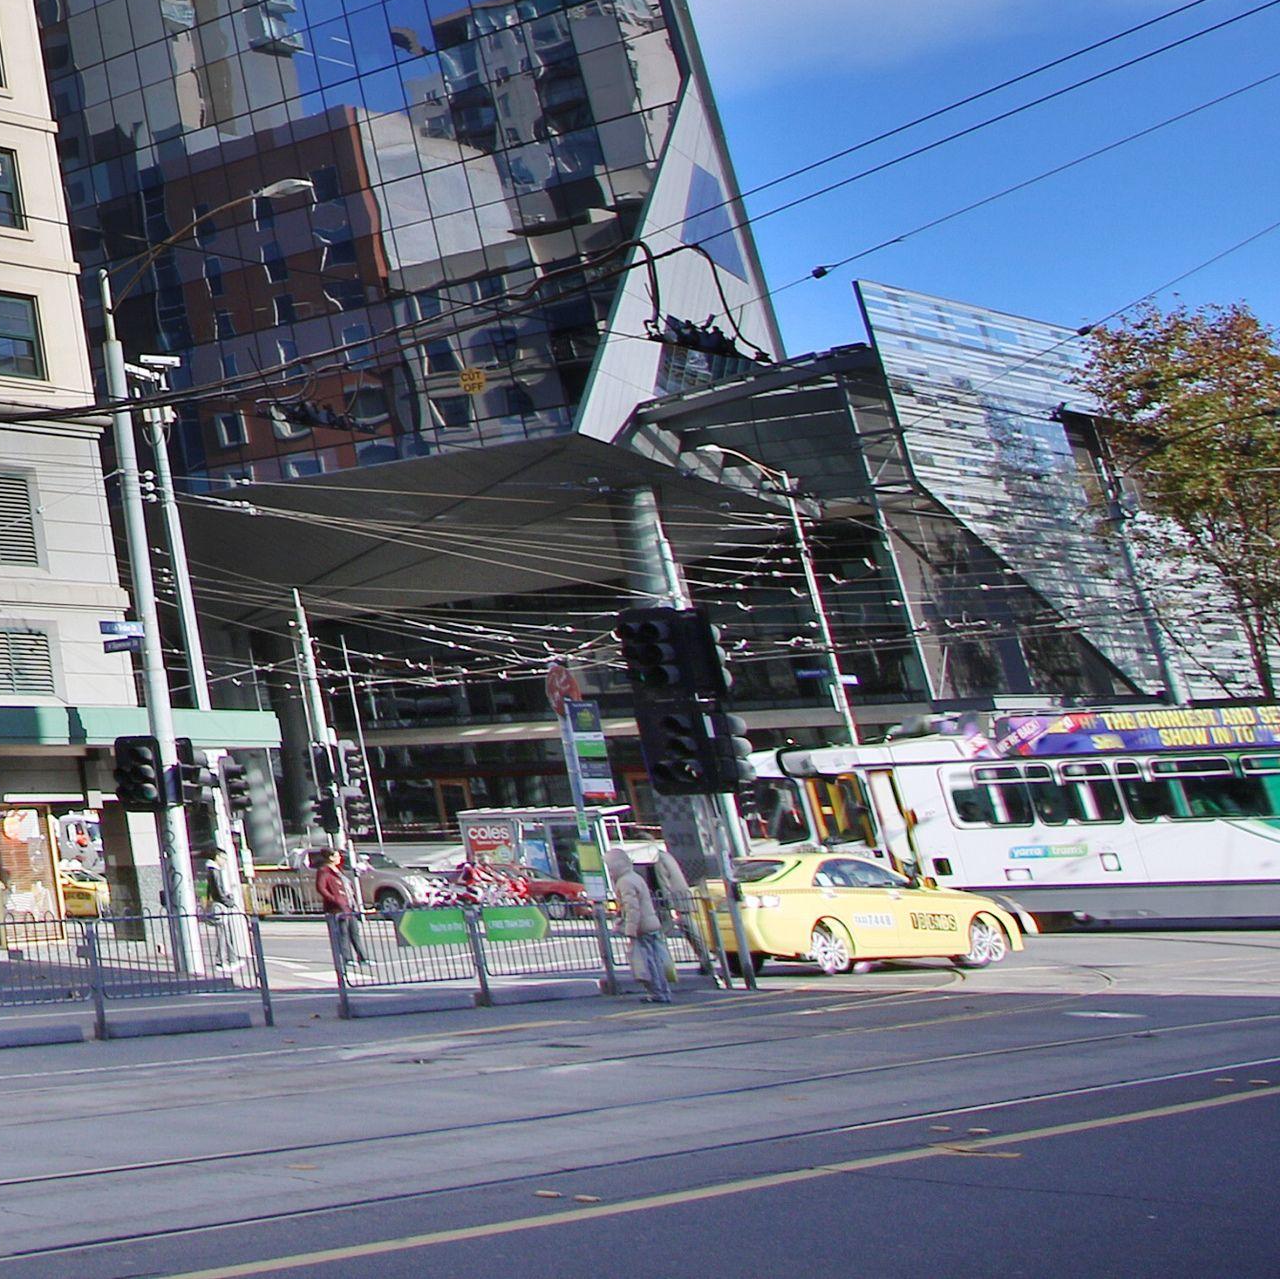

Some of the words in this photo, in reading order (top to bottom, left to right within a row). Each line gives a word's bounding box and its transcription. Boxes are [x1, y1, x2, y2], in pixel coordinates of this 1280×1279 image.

[461, 371, 480, 381] CUT
[464, 383, 483, 392] OFF
[1136, 709, 1217, 729] FUNNIEST
[1220, 708, 1256, 725] AND
[1159, 728, 1208, 747] SHOW
[1210, 727, 1232, 744] IN
[468, 826, 510, 839] coles
[1012, 848, 1041, 857] yarra
[1052, 846, 1084, 855] trams
